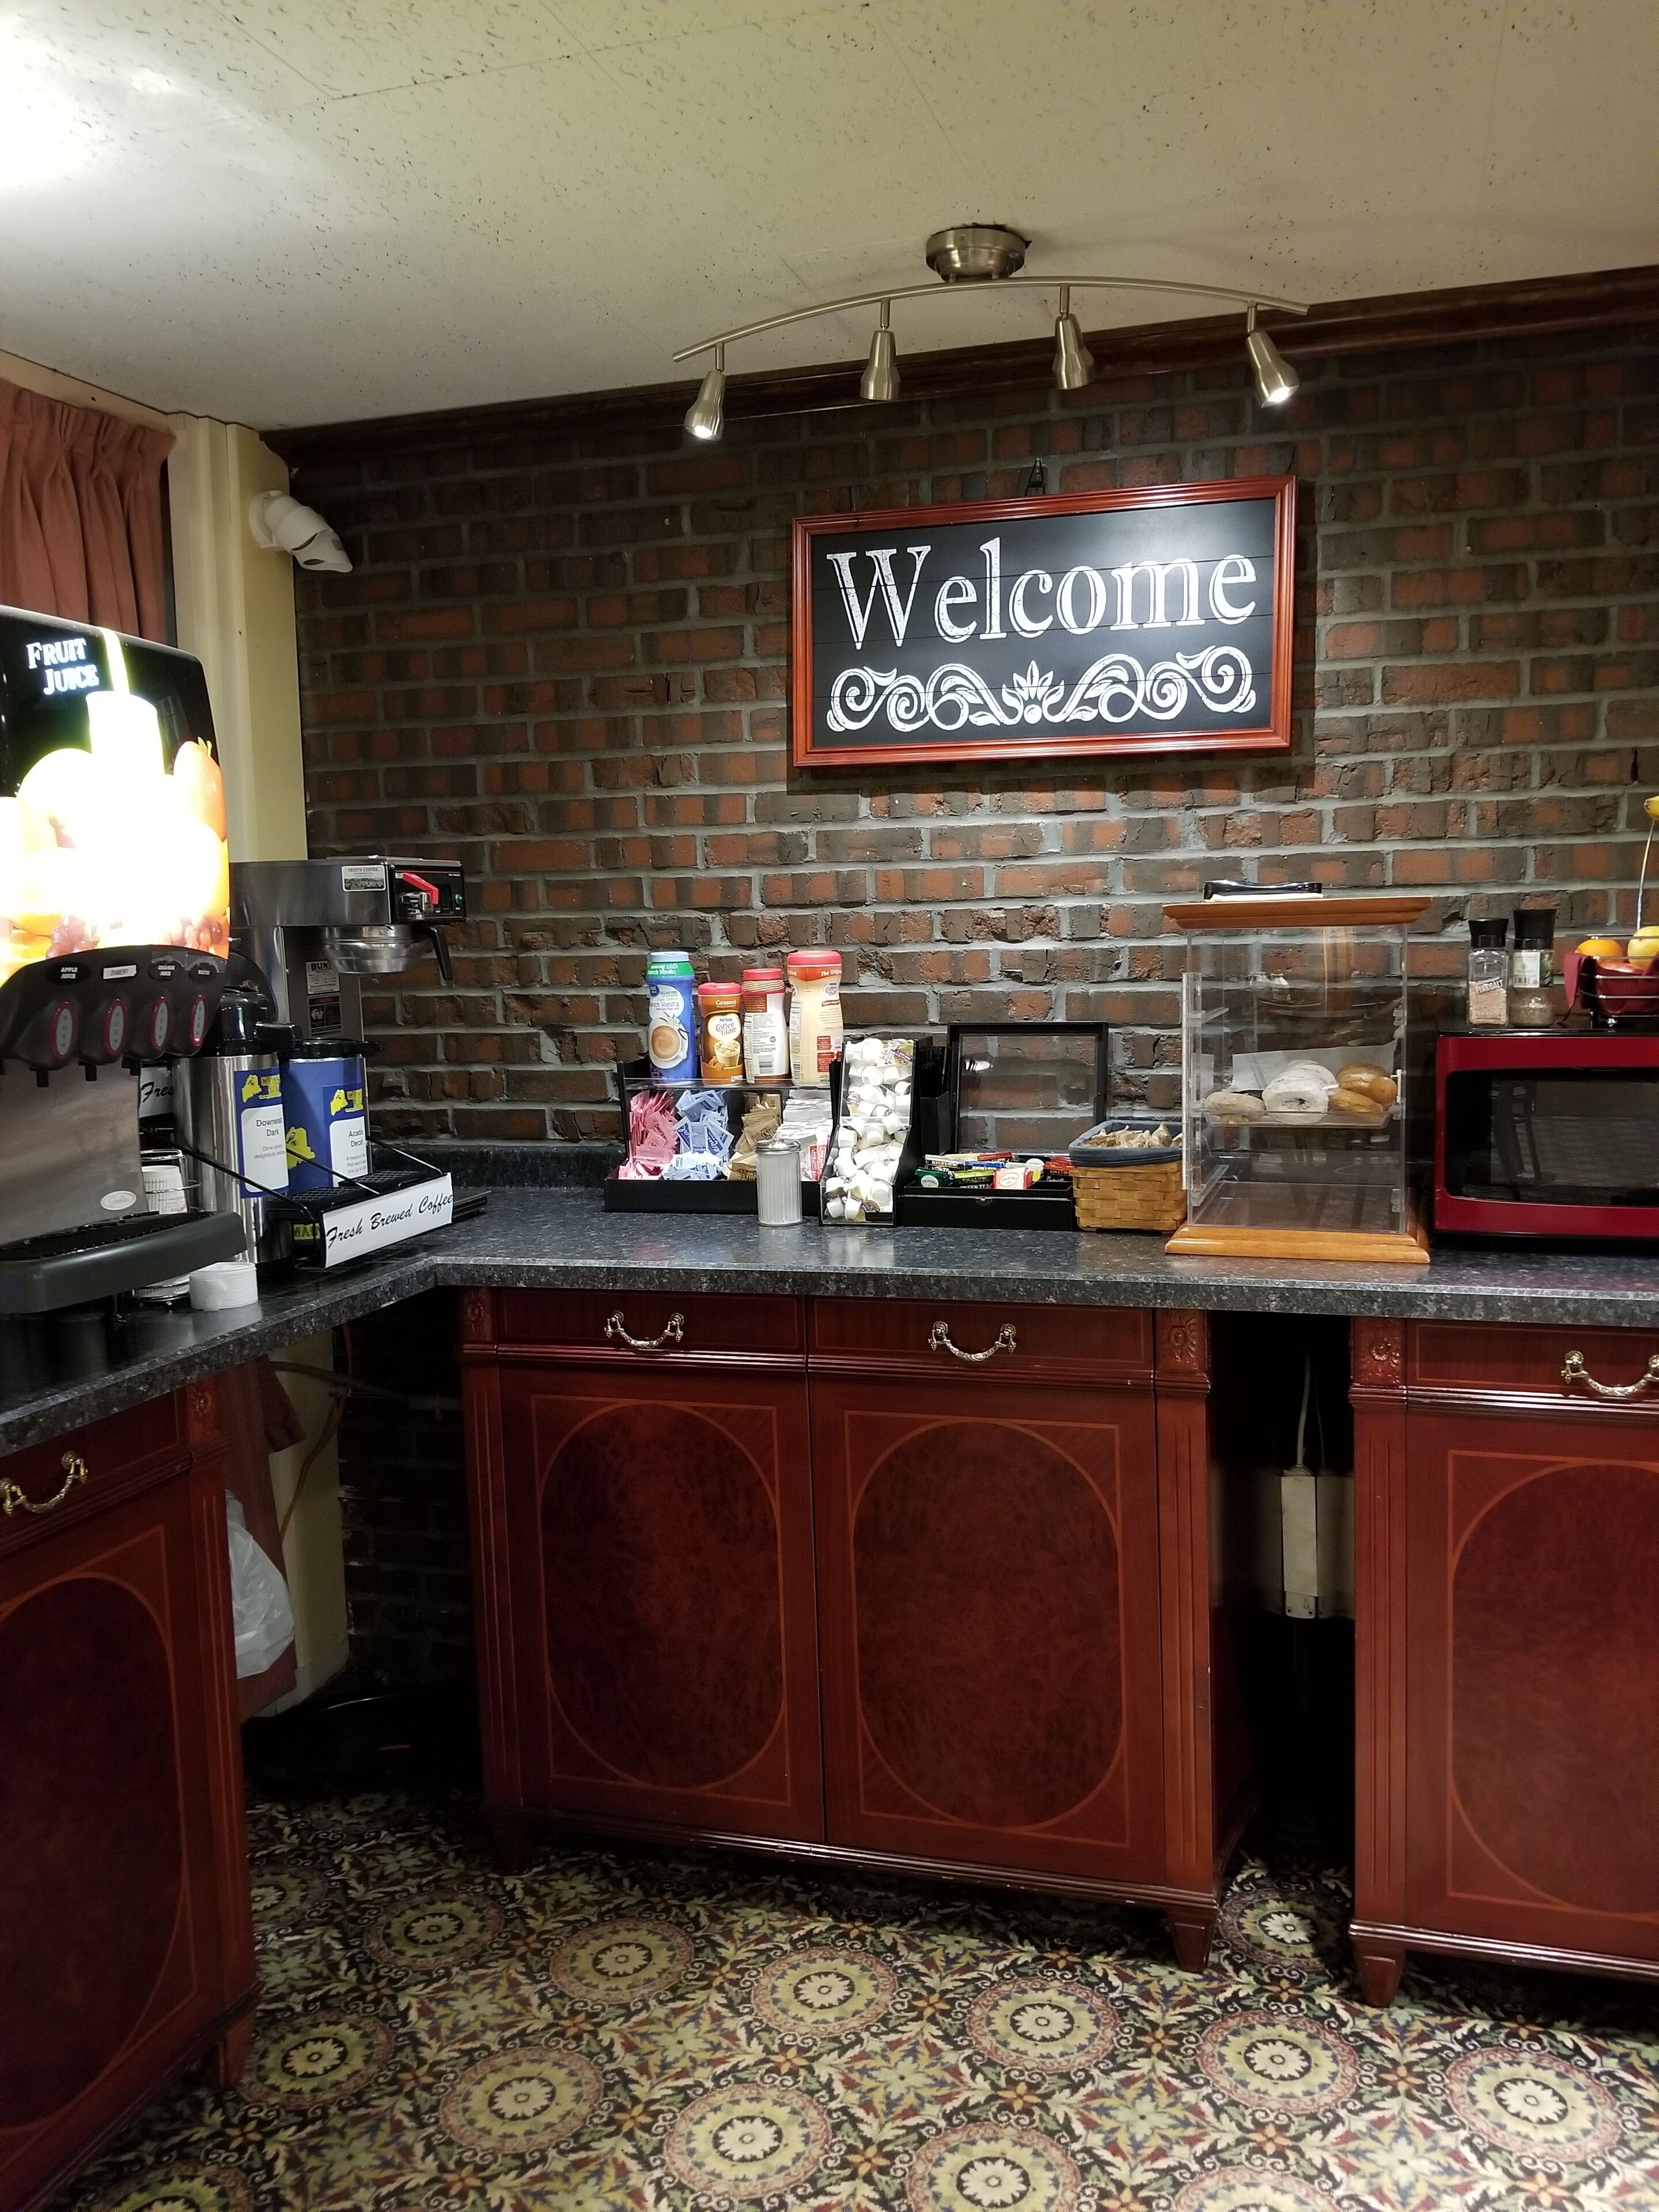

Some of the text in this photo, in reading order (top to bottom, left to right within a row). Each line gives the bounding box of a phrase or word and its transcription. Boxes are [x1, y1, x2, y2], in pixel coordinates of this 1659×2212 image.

[827, 537, 1257, 650] Welcome
[26, 638, 87, 669] FRUIT
[43, 664, 100, 695] JUICE
[141, 1081, 173, 1103] Fres
[325, 1218, 363, 1249] Fresh
[370, 1203, 413, 1230] Brewed
[418, 1192, 453, 1215] Coffee
